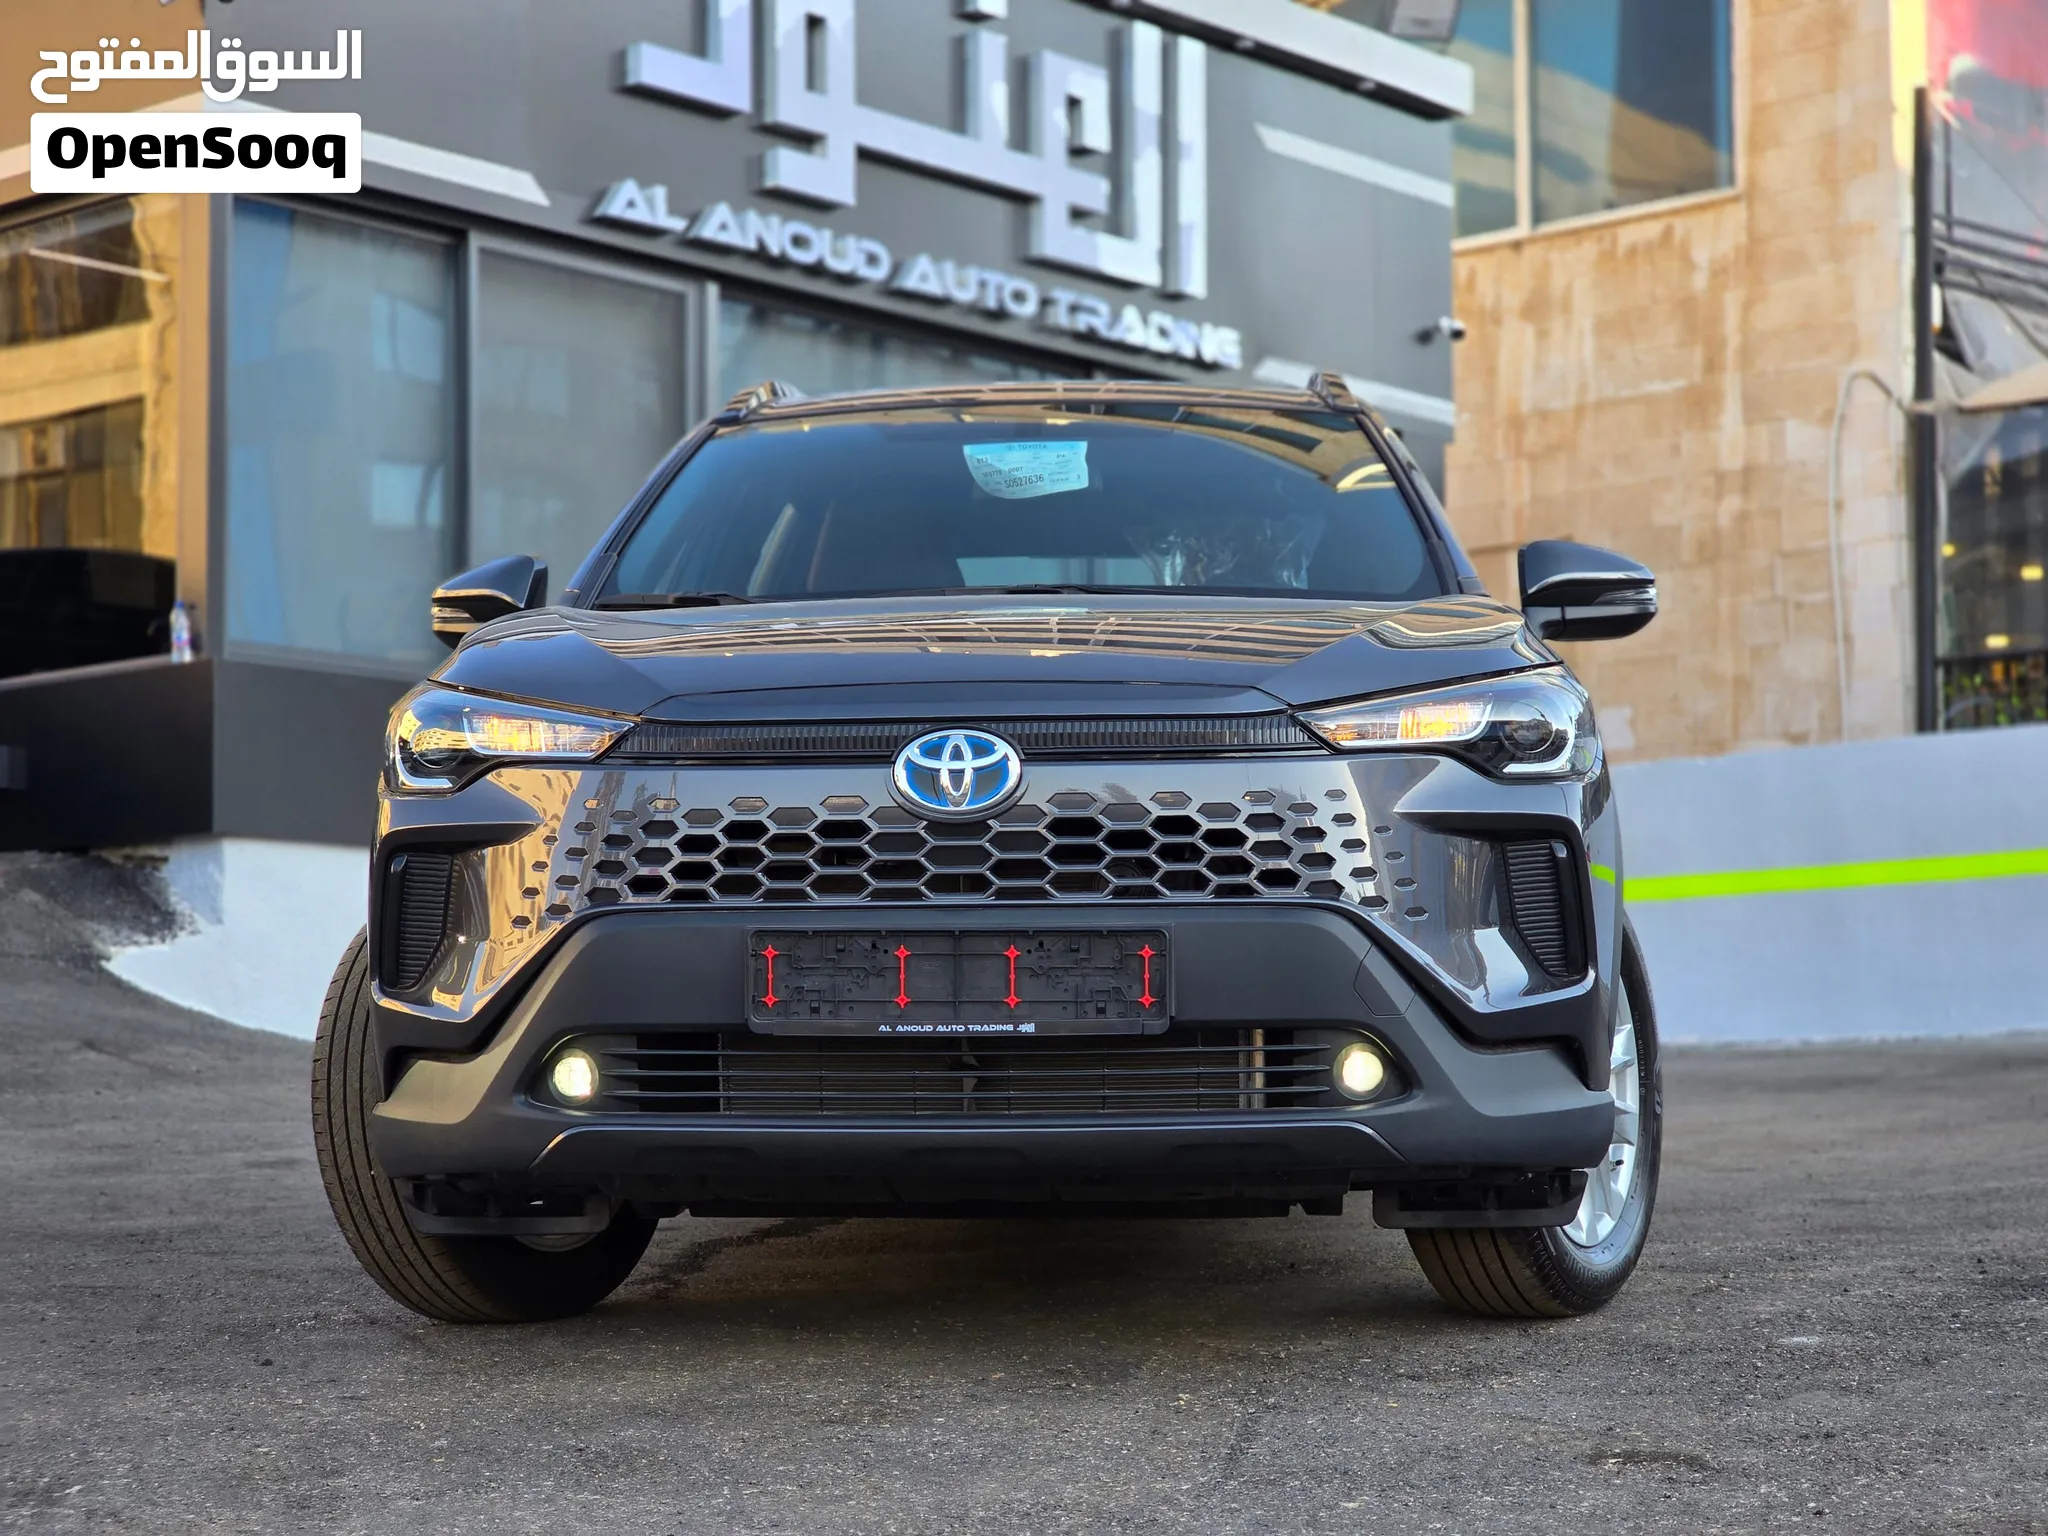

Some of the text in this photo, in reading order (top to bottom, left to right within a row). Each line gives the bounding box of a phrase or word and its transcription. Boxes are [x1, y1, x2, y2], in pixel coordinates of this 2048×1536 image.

[593, 177, 1243, 369] AL ANOUD AUTO TRADING
[878, 1024, 1014, 1032] AL ANOUD AUTO TRADING
